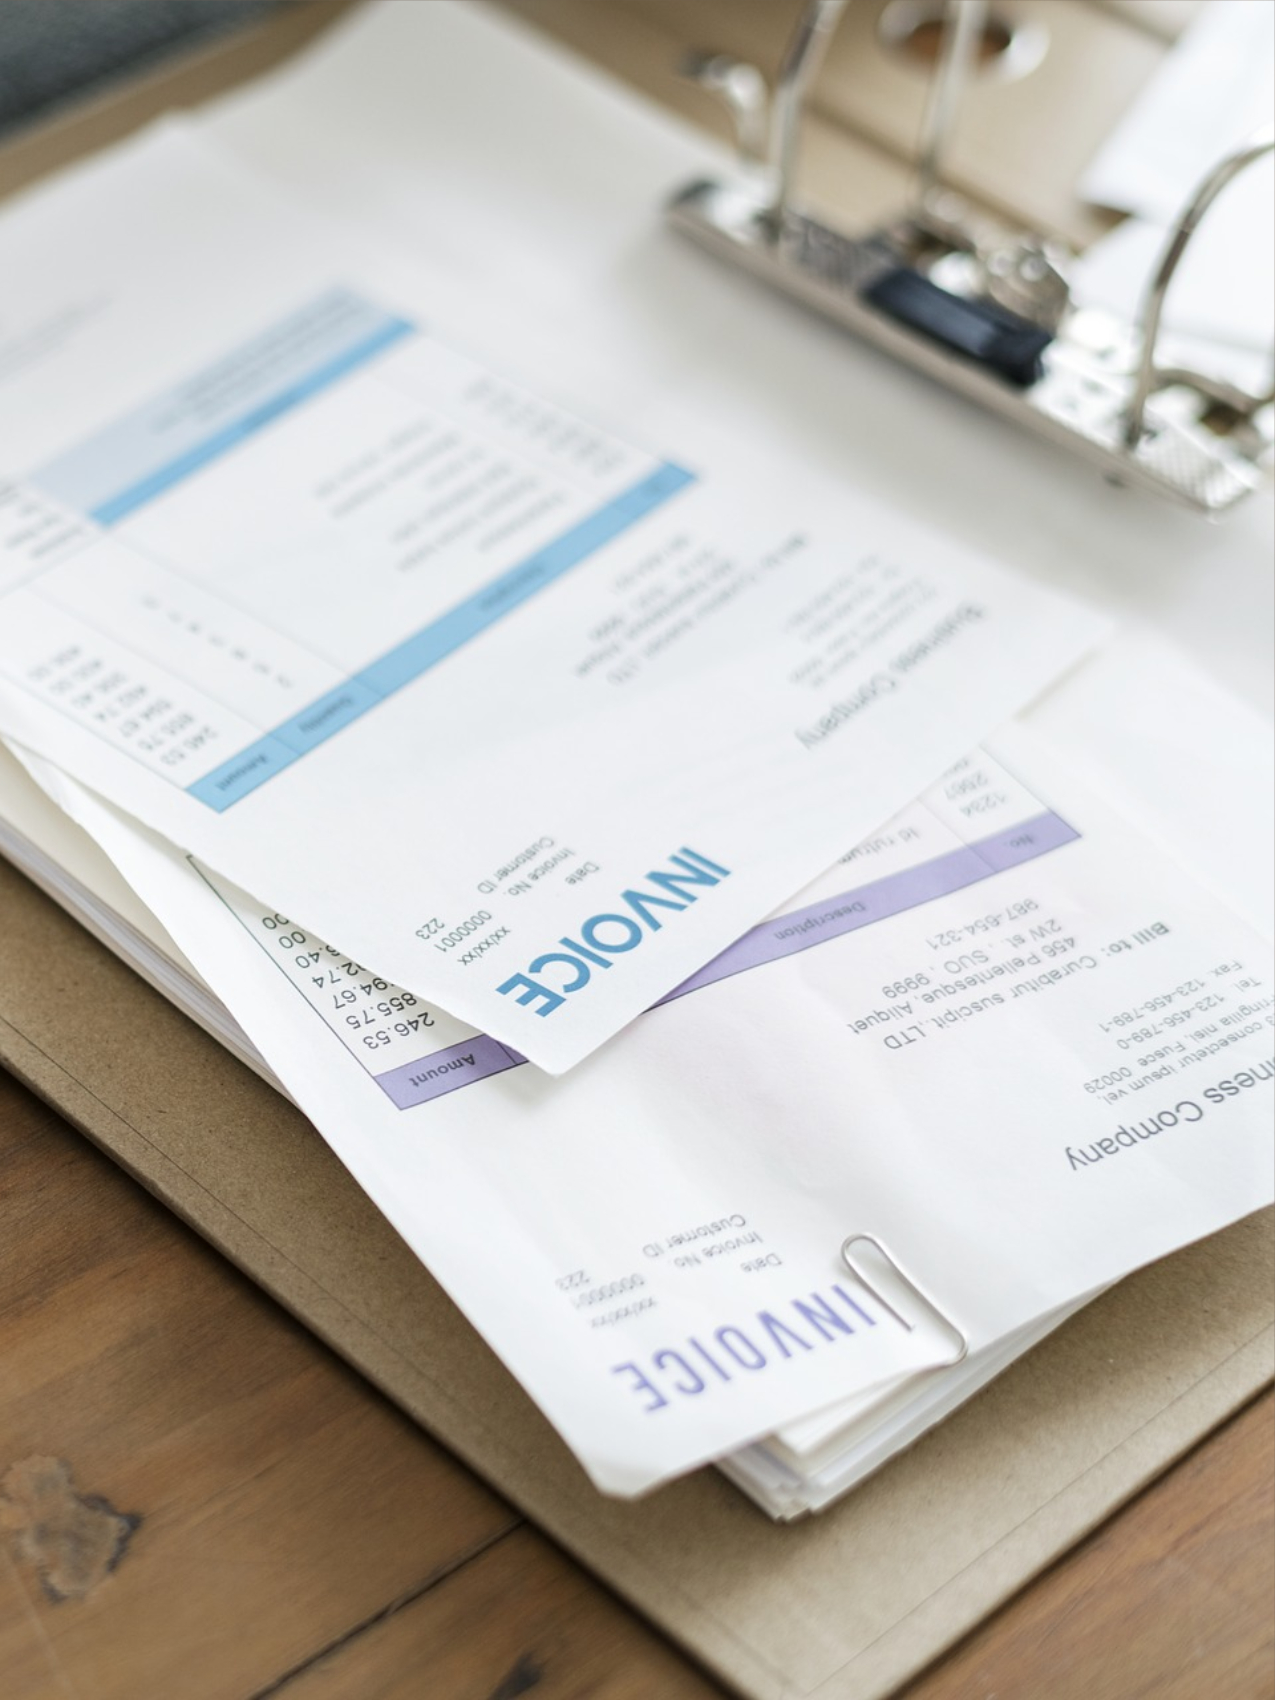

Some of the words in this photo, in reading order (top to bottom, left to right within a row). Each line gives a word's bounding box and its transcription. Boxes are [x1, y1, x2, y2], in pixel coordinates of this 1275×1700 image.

[493, 837, 555, 882] Customer
[527, 848, 575, 881] Invoice
[565, 861, 600, 885] Date
[477, 879, 498, 894] ID
[415, 917, 445, 940] 223
[434, 910, 492, 953] 0000001
[495, 846, 732, 1018] INVOICE
[774, 901, 867, 940] Description
[926, 898, 1039, 951] 987-654-321
[1028, 918, 1062, 941] 2W
[1132, 921, 1170, 945] Bill
[457, 926, 511, 966] xx/xx/xx
[1041, 936, 1076, 958] 456
[1101, 939, 1133, 957] to:
[333, 974, 396, 1009] 94.67
[882, 973, 931, 999] 9999
[914, 952, 1042, 1004] Pellentesque,
[1010, 955, 1098, 998] Curabitur
[346, 990, 418, 1030] 855.75
[847, 1001, 913, 1035] Aliquet
[1098, 979, 1206, 1033] 123-456-789-1
[1116, 994, 1225, 1050] 123-456-789-0
[363, 1007, 436, 1049] 246.53
[1178, 1022, 1263, 1068] consectetur
[409, 1049, 478, 1087] Amount
[1137, 1041, 1186, 1067] Fusce
[1083, 1066, 1133, 1094] 00029
[1128, 1064, 1177, 1091] ipsum
[1203, 1053, 1275, 1104] iness
[1065, 1100, 1204, 1171] Company
[667, 1214, 747, 1249] Customer
[701, 1231, 764, 1258] Invoice
[642, 1242, 665, 1259] ID
[740, 1252, 783, 1273] Date
[613, 1283, 877, 1412] INVOICE
